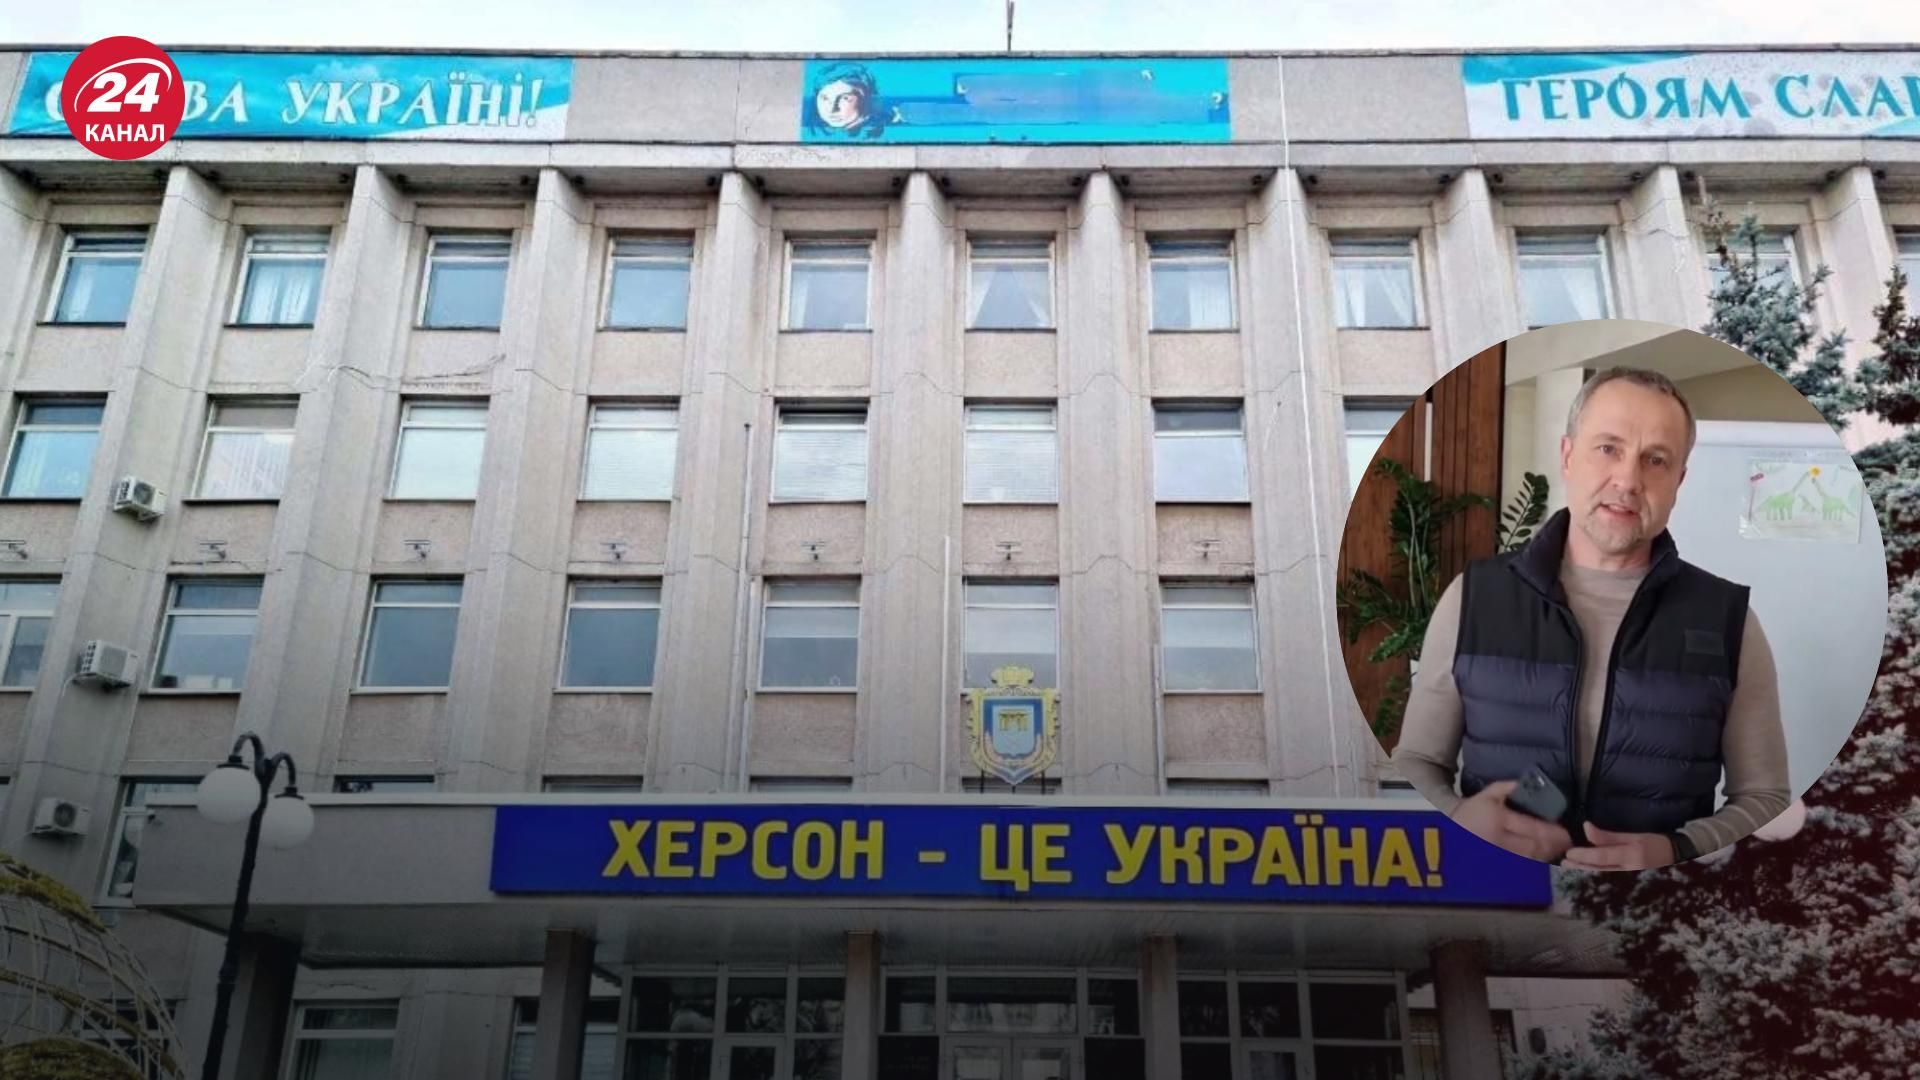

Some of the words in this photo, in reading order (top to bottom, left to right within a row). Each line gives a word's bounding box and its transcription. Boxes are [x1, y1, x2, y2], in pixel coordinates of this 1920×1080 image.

[1501, 73, 1751, 120] ГЕРОЯМ
[602, 820, 884, 880] ХЕРСОН
[918, 850, 946, 863] -
[980, 824, 1073, 892] ЦЕ
[1103, 815, 1444, 888] УКРАЇНА!
